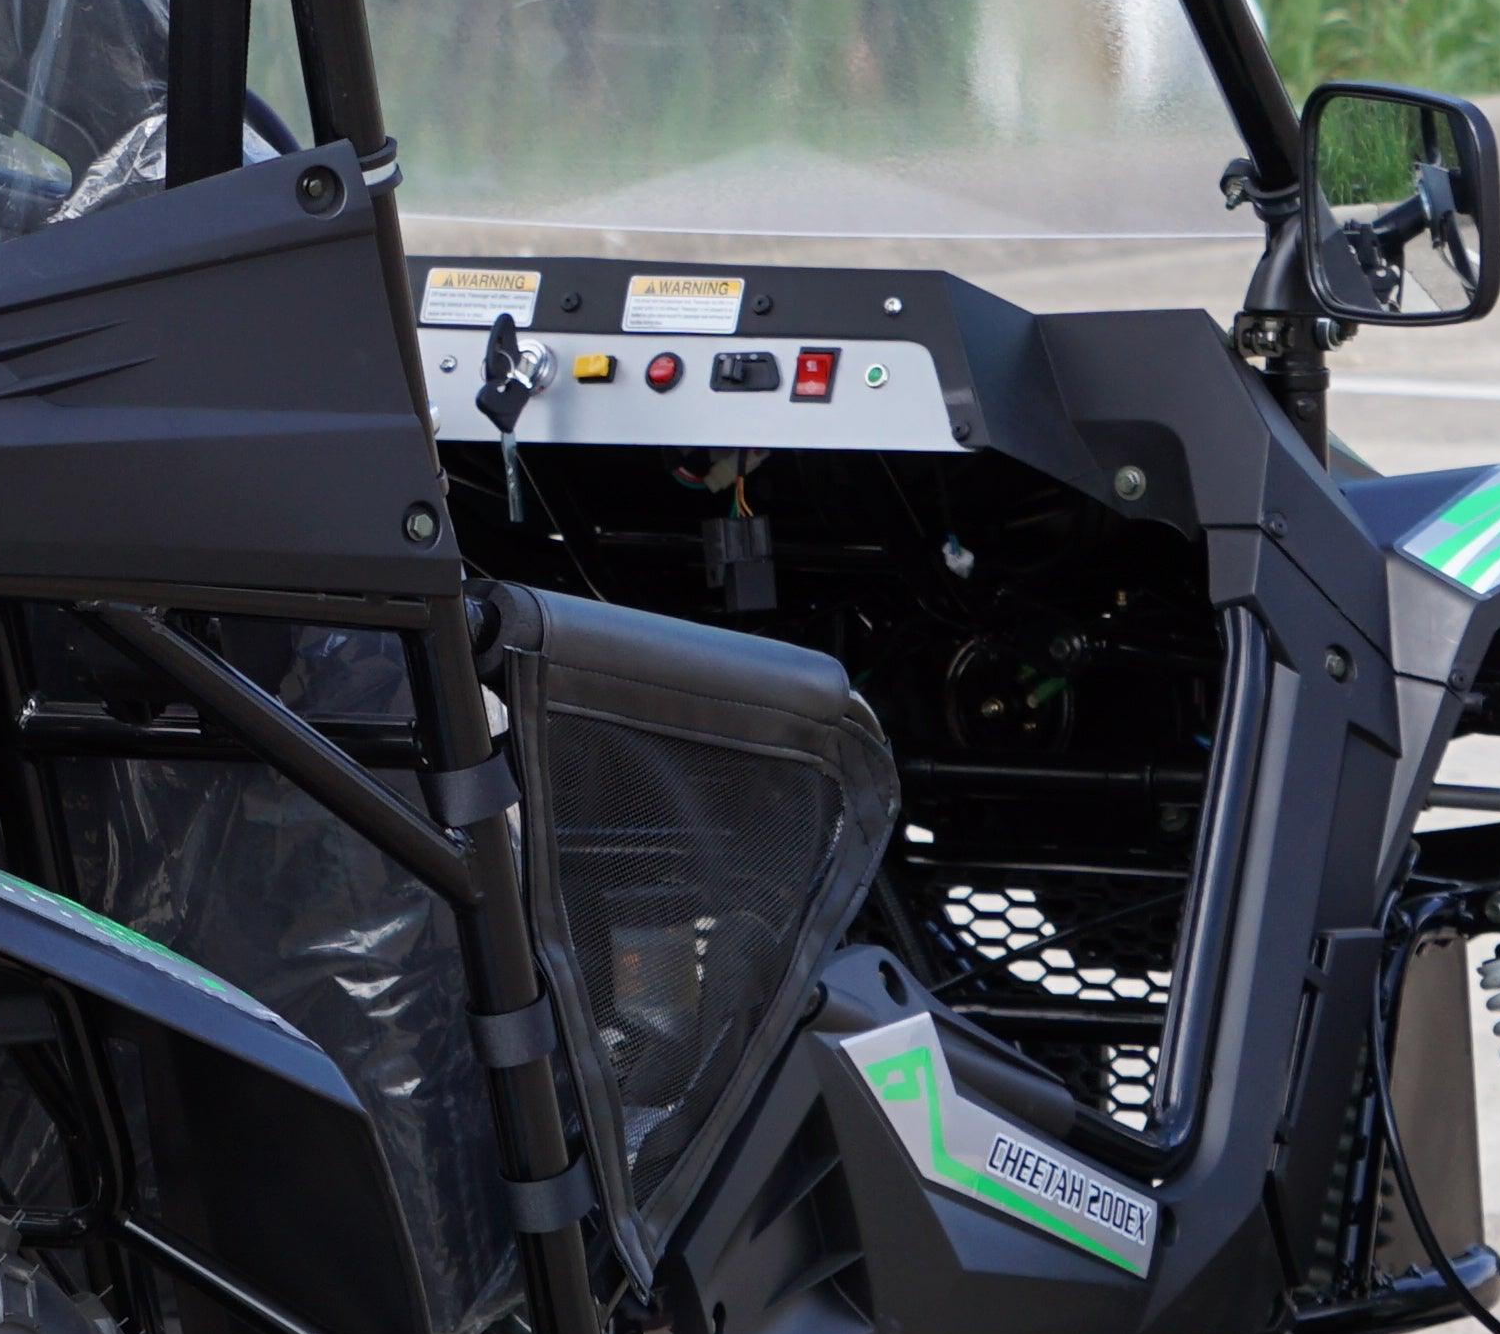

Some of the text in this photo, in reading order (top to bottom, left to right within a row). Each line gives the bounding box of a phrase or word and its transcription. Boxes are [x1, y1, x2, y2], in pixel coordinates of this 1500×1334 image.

[457, 274, 526, 289] WARNING
[659, 281, 730, 296] WARNING
[987, 1135, 1150, 1242] CHEETAH 200EX
